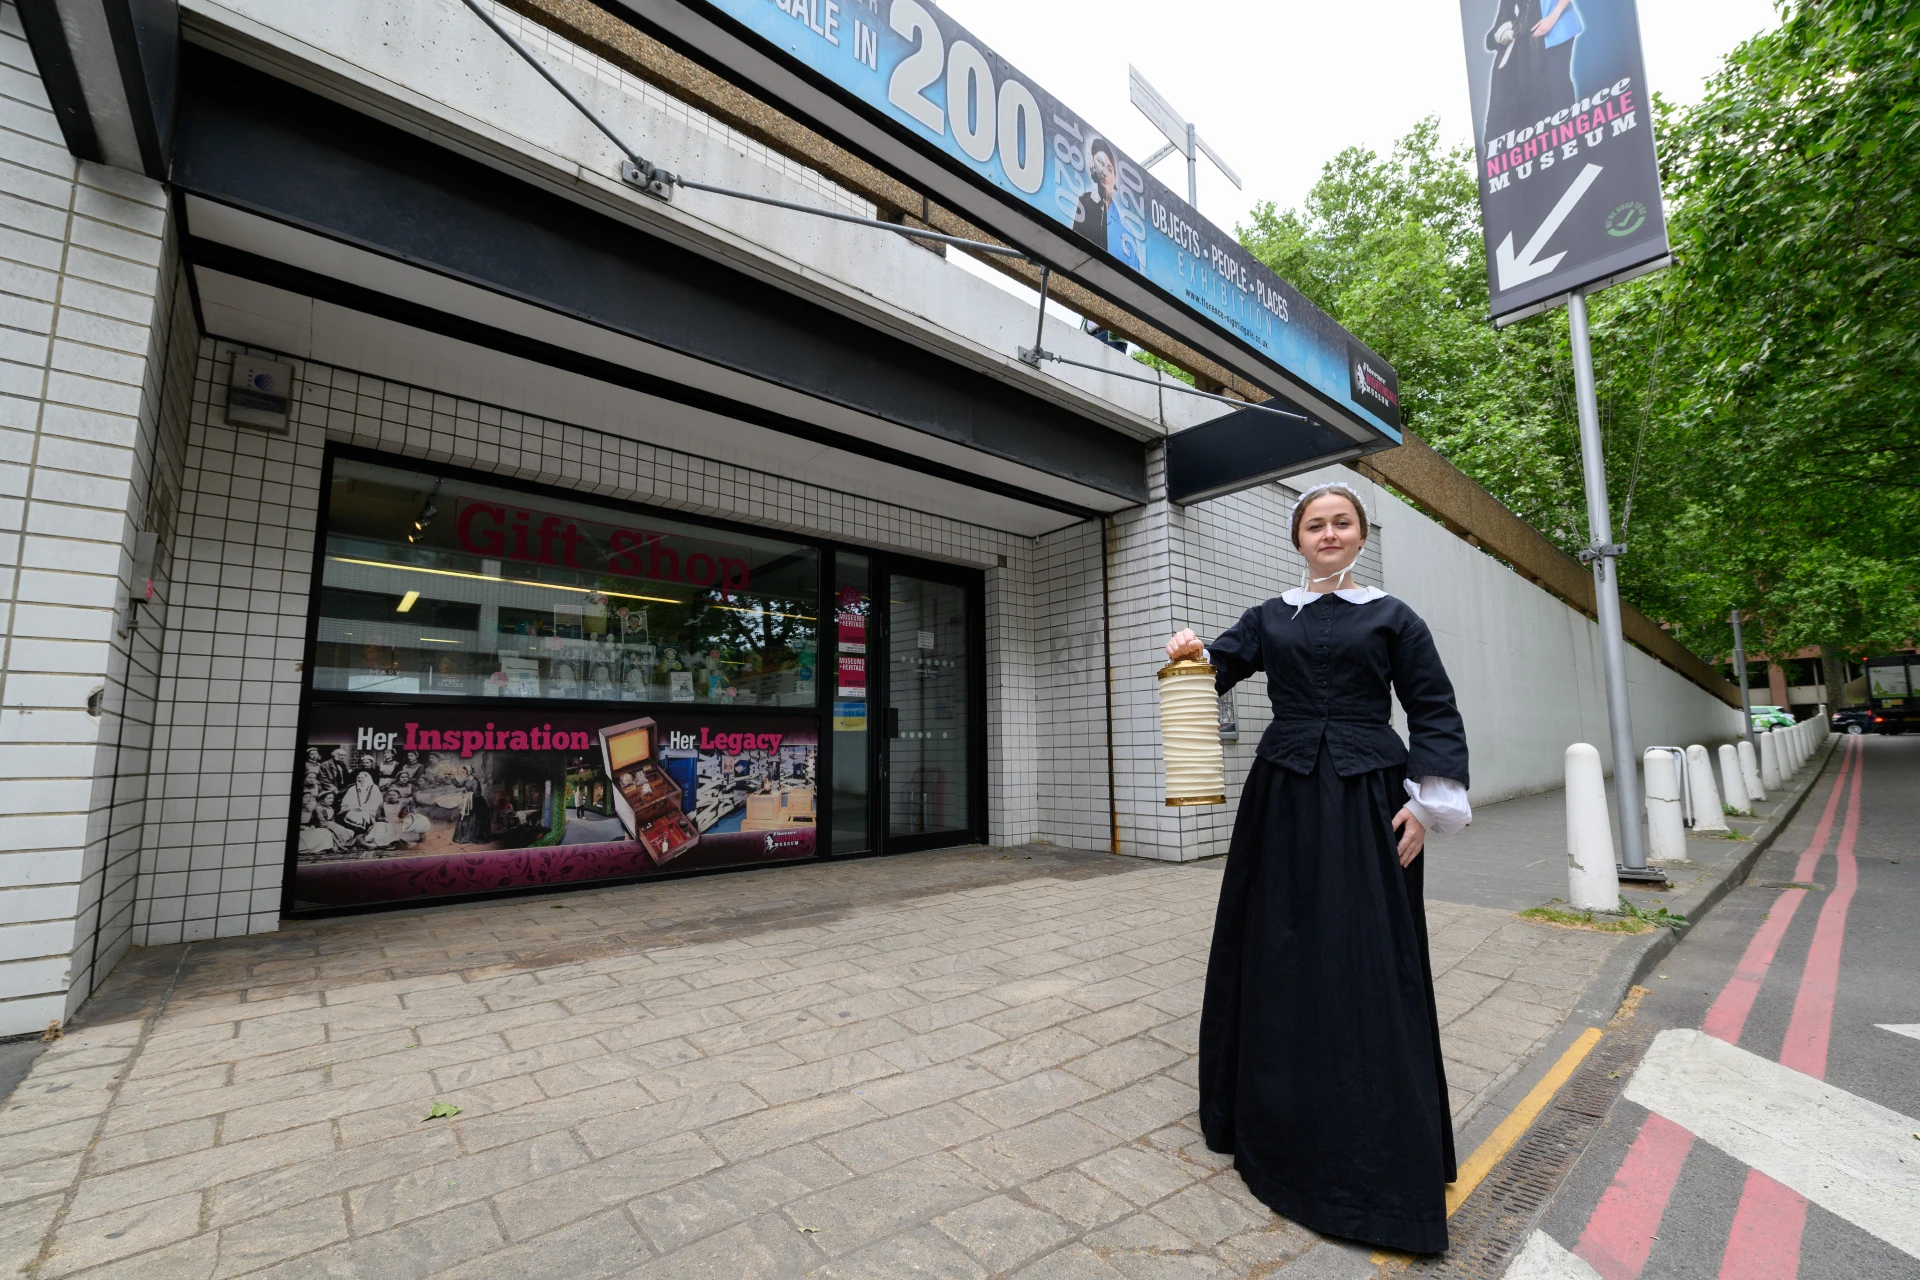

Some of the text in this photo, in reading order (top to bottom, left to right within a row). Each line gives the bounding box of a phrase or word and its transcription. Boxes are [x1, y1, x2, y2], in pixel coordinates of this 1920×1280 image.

[854, 18, 877, 72] IN
[888, 0, 1045, 194] 200
[1486, 77, 1631, 159] Florence
[1487, 90, 1634, 178] NIGHTINGALE
[1053, 113, 1086, 225] 1820
[1489, 110, 1637, 194] MUSEUM
[1118, 160, 1148, 275] 2020
[1615, 201, 1634, 213] GOOD
[1151, 199, 1289, 323] OBJECTS PEOPLE PLACES
[1177, 250, 1272, 338] EXHIBITION
[1185, 288, 1269, 350] www.florence-nightingale.co.uk
[457, 503, 750, 599] Gift Shop
[357, 722, 590, 759] Her Inspiration
[670, 727, 783, 757] Her Legacy
